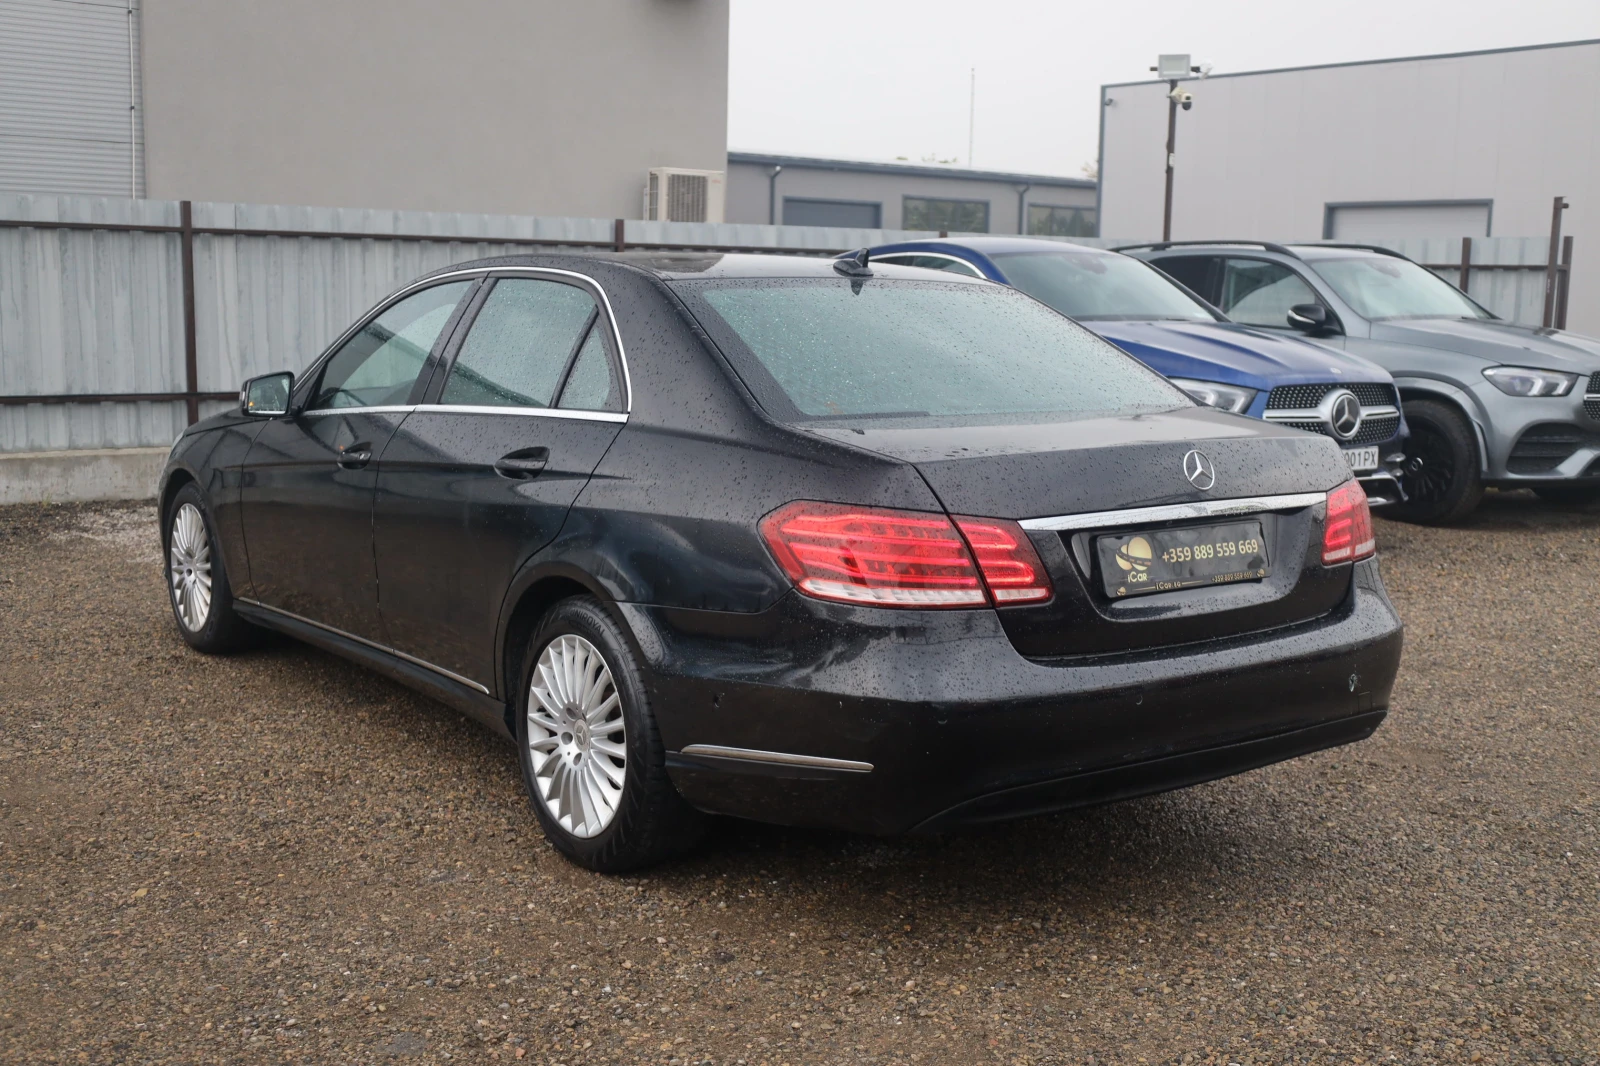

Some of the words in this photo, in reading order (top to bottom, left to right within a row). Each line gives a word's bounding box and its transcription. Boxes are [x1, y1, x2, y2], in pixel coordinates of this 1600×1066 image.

[1162, 547, 1192, 563] +359
[1193, 544, 1214, 560] 889
[1216, 541, 1236, 557] 559
[1238, 539, 1258, 555] 669
